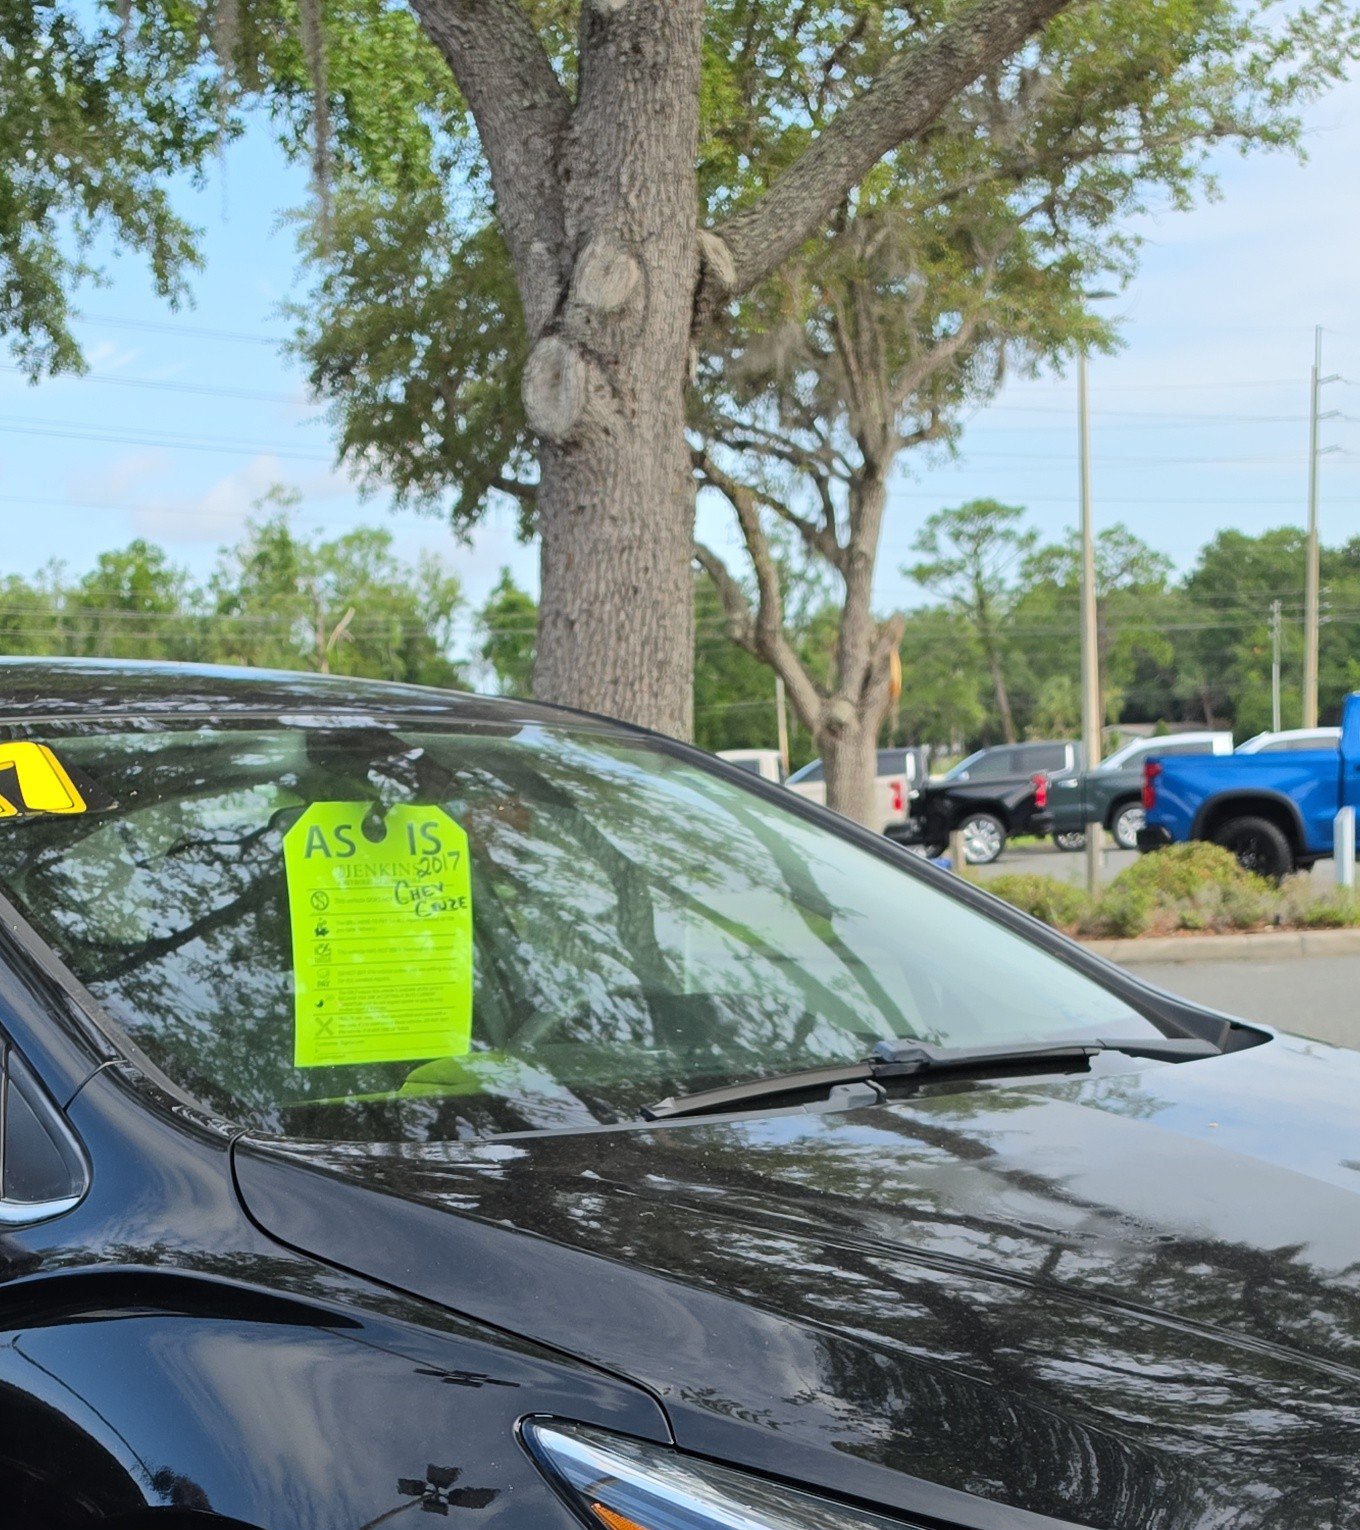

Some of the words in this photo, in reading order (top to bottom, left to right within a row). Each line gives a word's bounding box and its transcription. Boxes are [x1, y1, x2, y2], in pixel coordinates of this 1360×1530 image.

[304, 823, 357, 859] AS
[406, 821, 443, 856] IS
[416, 851, 460, 877] 2017
